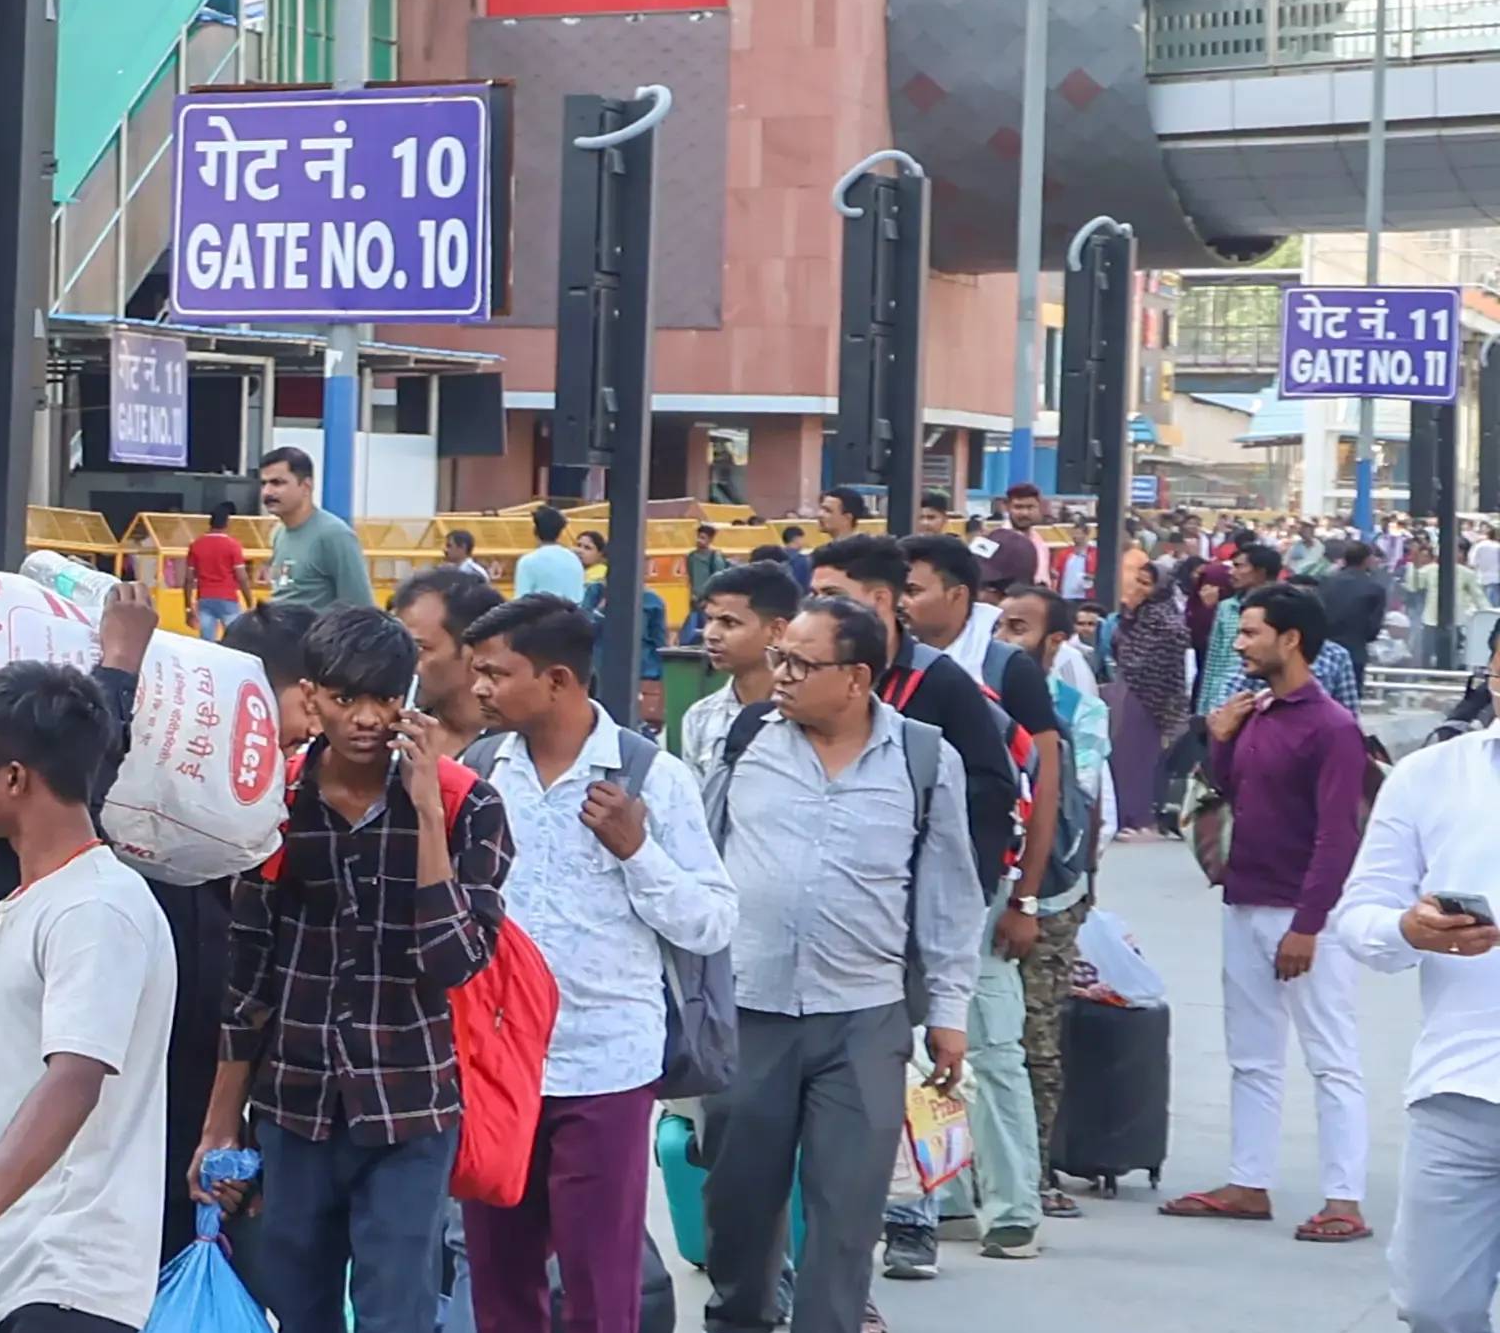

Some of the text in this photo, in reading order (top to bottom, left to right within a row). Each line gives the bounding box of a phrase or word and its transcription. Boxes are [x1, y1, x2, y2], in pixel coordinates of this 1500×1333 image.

[194, 116, 467, 201] गेट नं. 10
[186, 217, 469, 290] GATE NO. 10
[1295, 294, 1450, 342] गेट नं. 11
[118, 339, 142, 392] गेट
[165, 360, 183, 396] 11
[1290, 348, 1447, 387] GATE NO. 11
[119, 402, 148, 444] GATE
[193, 701, 221, 729] डी
[184, 734, 215, 758] पी
[236, 694, 269, 788] G-Lex
